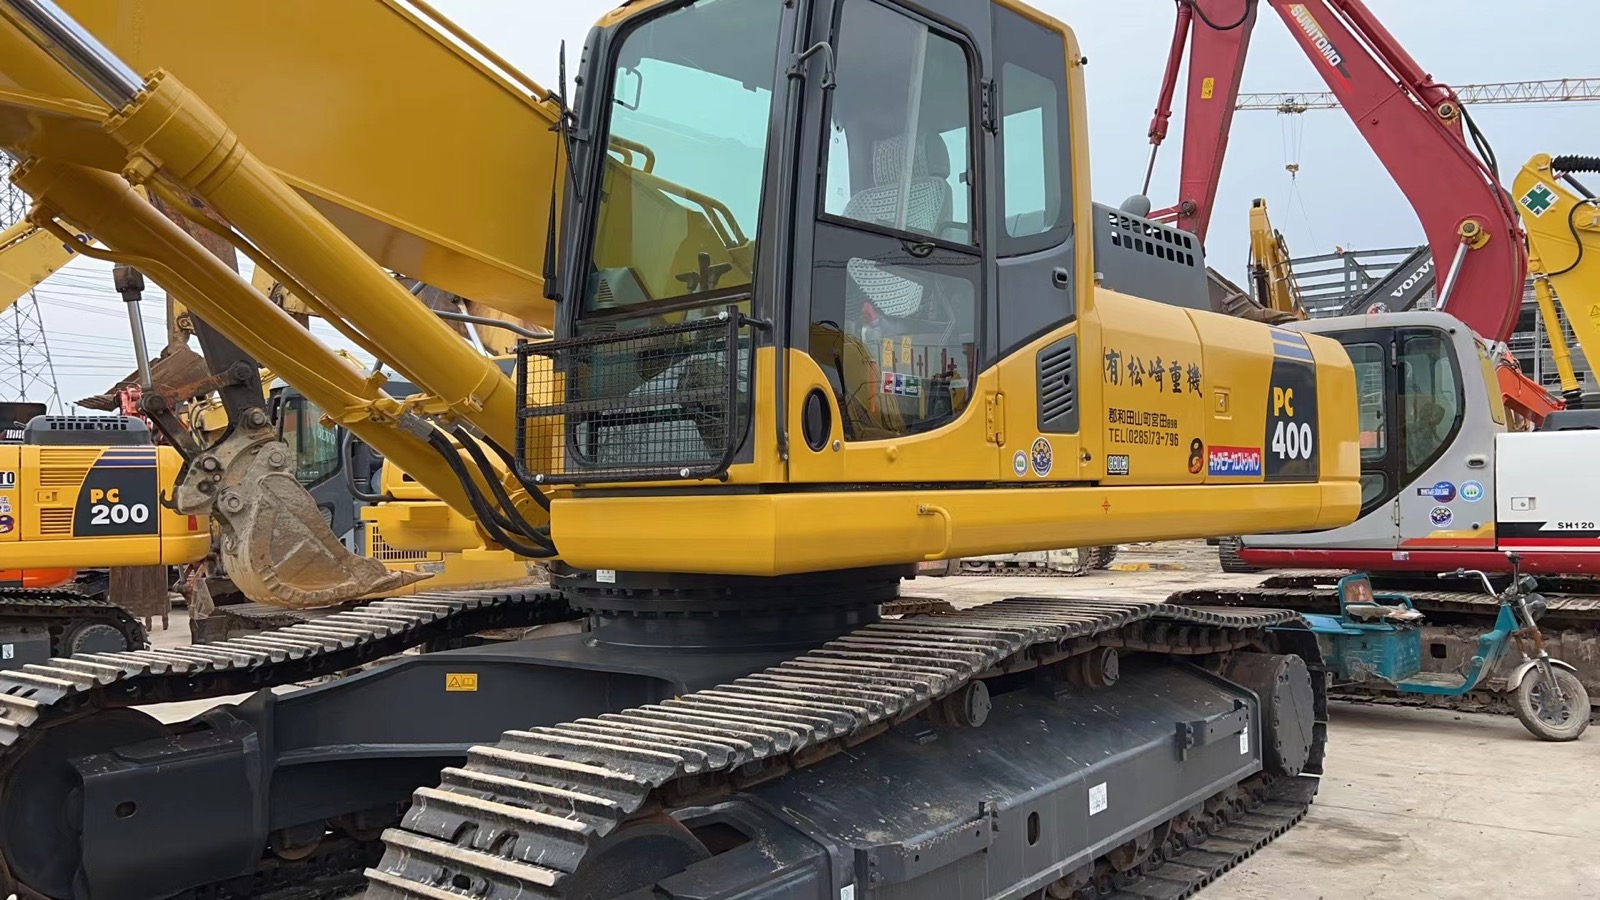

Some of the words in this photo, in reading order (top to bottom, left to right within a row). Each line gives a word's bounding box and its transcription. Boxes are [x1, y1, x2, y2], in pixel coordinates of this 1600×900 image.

[1291, 5, 1341, 67] SUMITOMO
[1273, 386, 1294, 417] PC
[1271, 421, 1313, 460] 400
[90, 488, 120, 504] PC
[90, 503, 149, 525] 200
[1557, 521, 1595, 529] SH120
